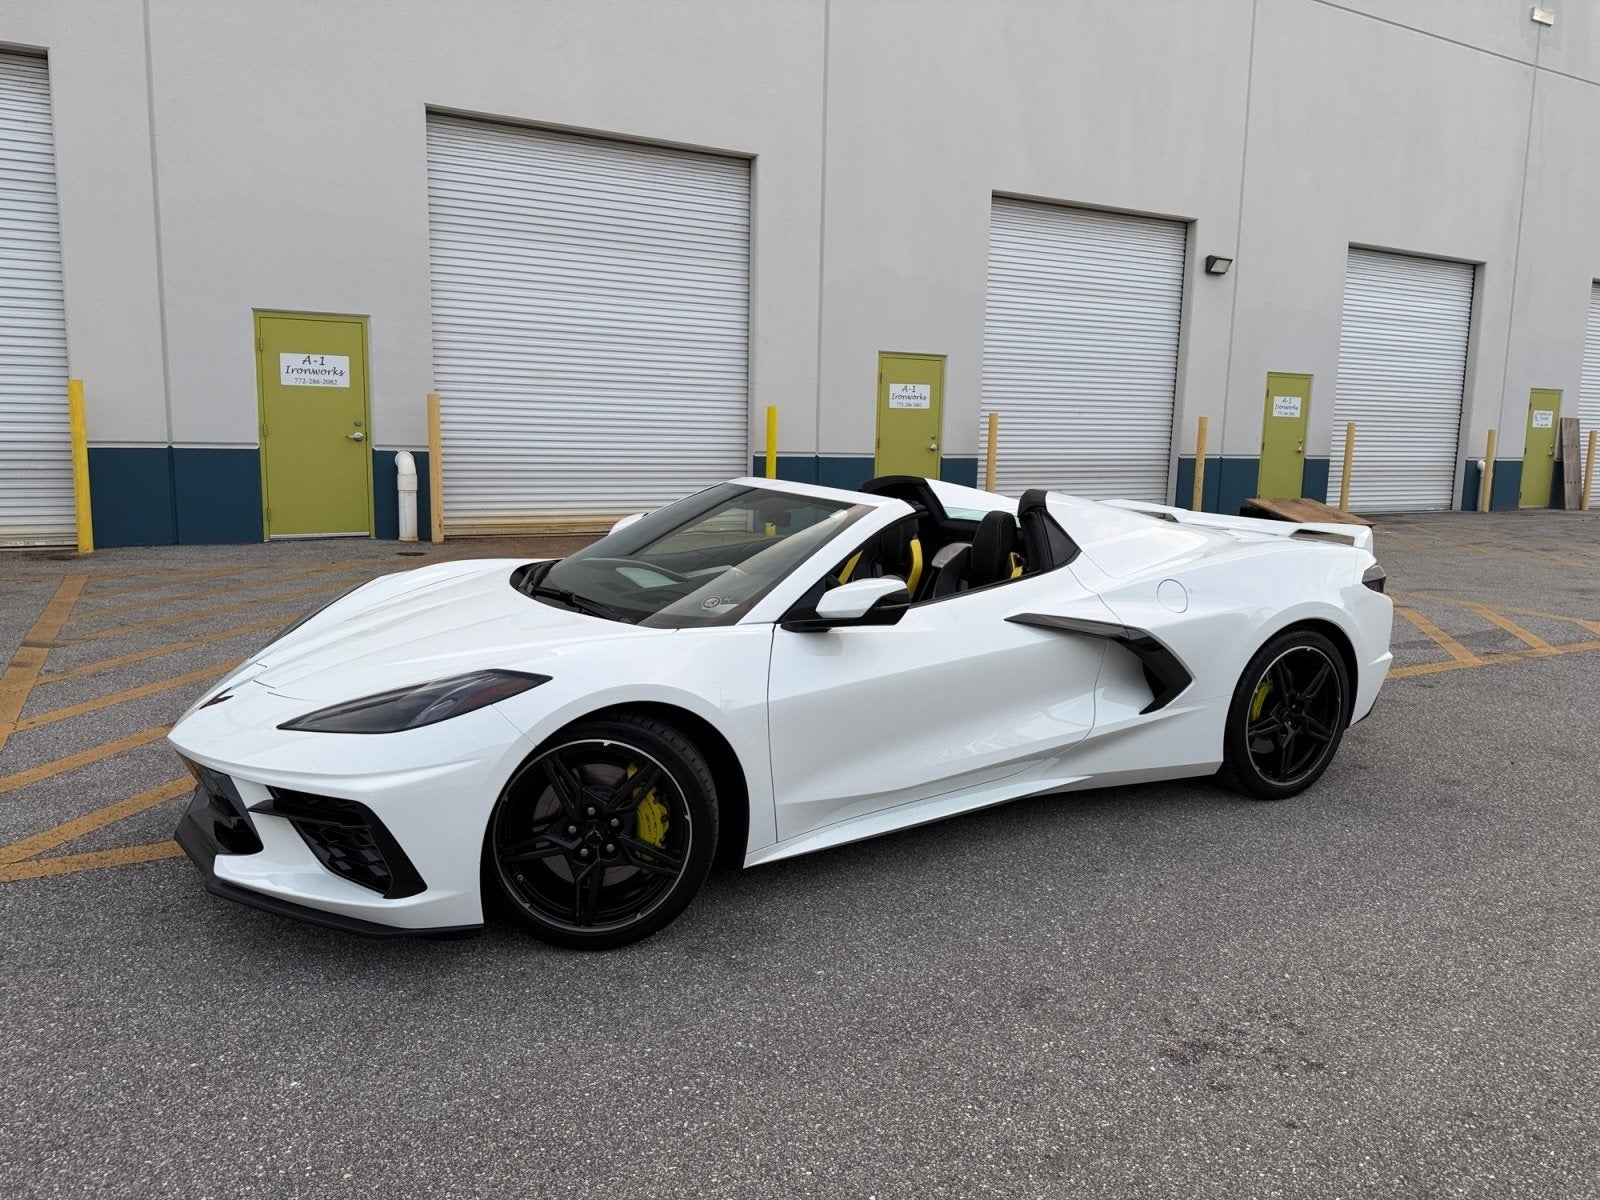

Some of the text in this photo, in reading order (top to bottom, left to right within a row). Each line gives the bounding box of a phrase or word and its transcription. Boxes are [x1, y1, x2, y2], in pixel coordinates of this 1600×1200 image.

[302, 355, 326, 365] A-1
[285, 365, 346, 376] Ironworks
[294, 377, 338, 386] 772-286-2082
[891, 392, 927, 401] Ironworks
